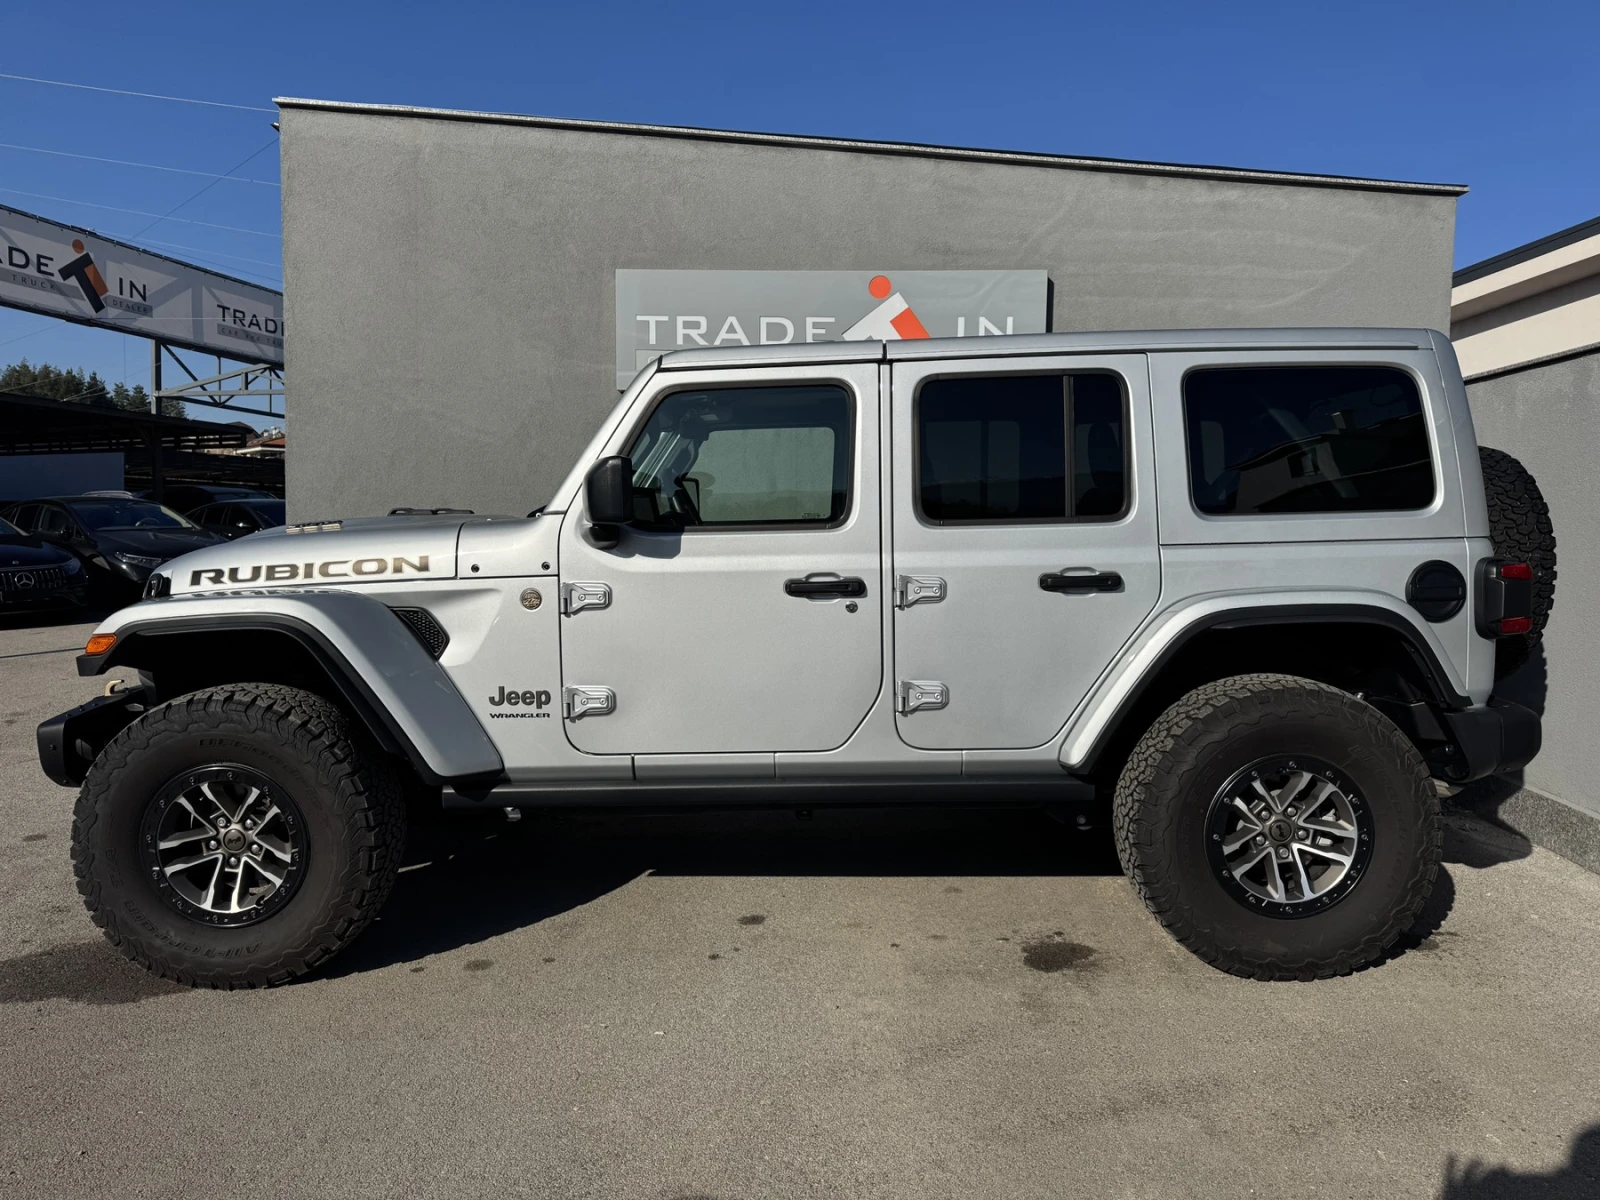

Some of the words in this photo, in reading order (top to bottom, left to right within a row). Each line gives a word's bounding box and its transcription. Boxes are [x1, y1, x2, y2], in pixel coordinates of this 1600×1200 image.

[0, 245, 55, 277] DE
[119, 276, 147, 302] IN
[12, 274, 56, 291] TRUCK
[216, 304, 284, 337] TRAD
[635, 315, 836, 346] TRADE
[957, 315, 1014, 338] IN
[189, 555, 430, 587] RUBICON
[488, 685, 552, 710] Jeep
